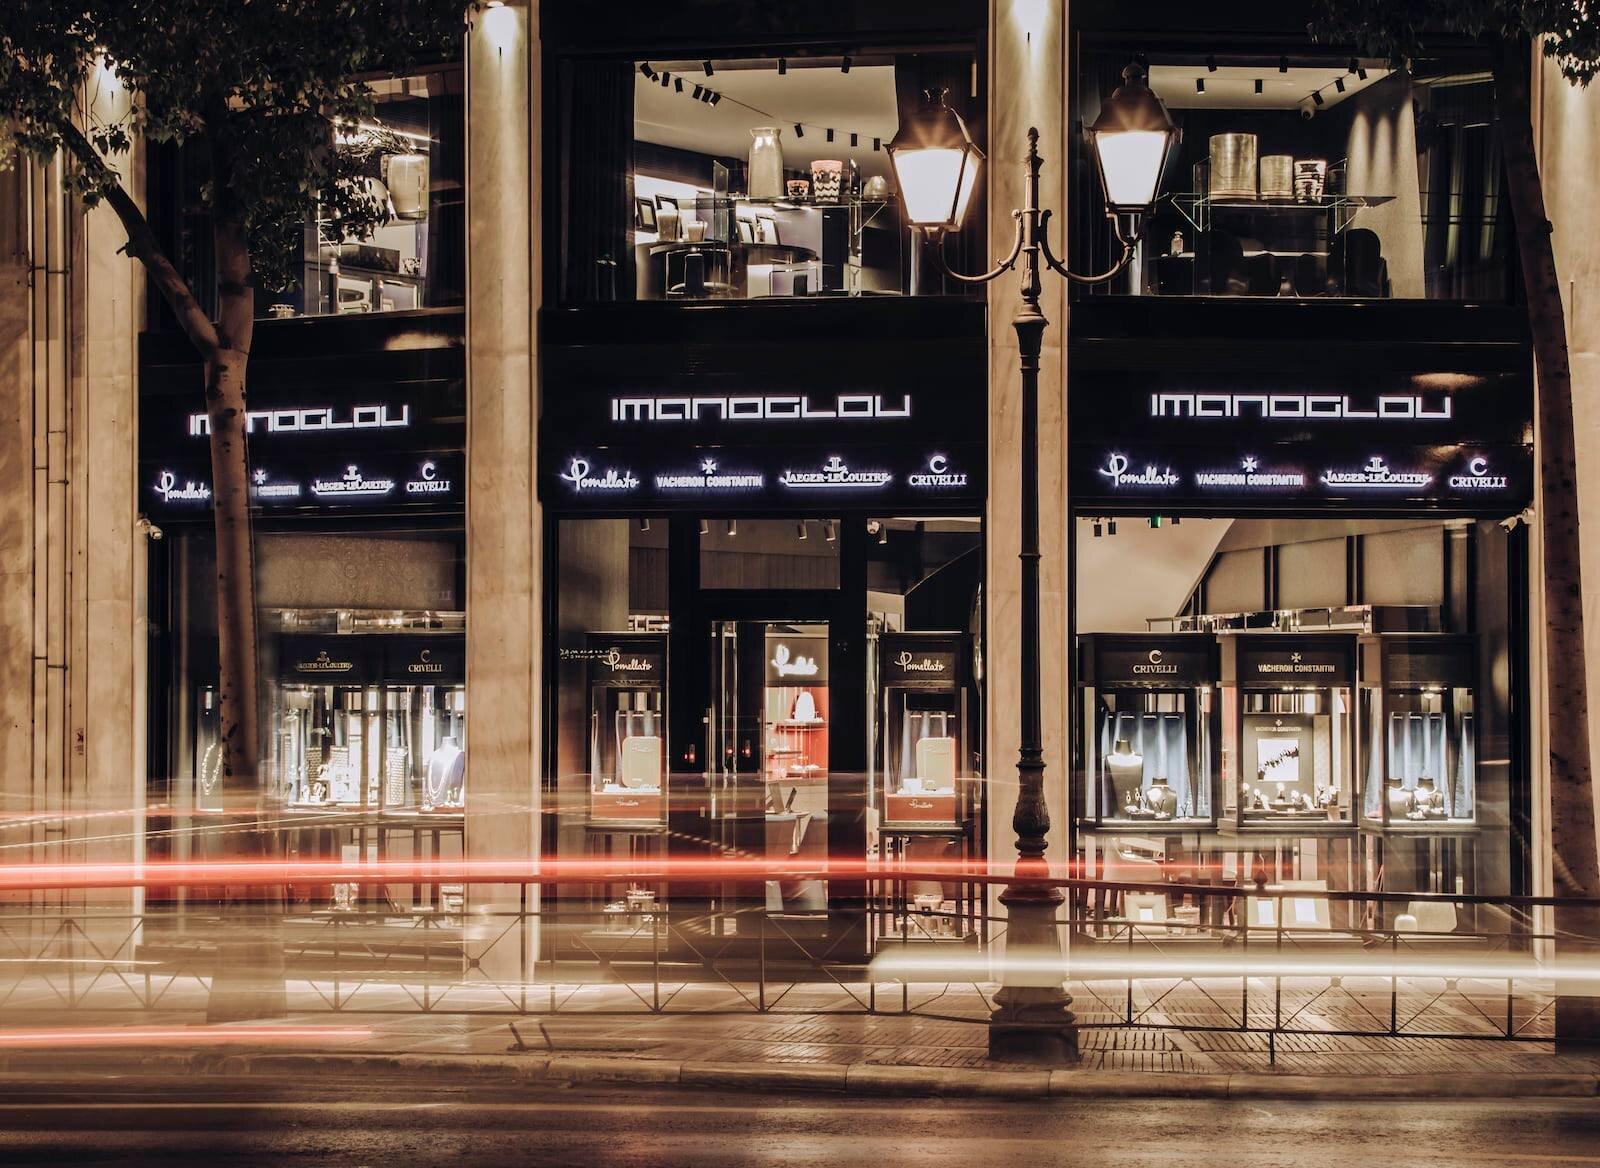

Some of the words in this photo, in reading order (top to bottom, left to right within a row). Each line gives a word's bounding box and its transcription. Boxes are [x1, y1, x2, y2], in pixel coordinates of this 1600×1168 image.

[560, 457, 640, 492] Pomellato
[1099, 453, 1180, 487] Pomellato
[406, 480, 450, 492] CRIVELLI
[656, 476, 705, 488] VACHERON
[706, 475, 763, 487] CONSTANTIN
[908, 474, 967, 487] CRIVELLI
[1196, 474, 1245, 486] VACHERON
[1246, 474, 1304, 486] CONSTANTIN
[1449, 476, 1507, 488] CRIVELLI
[602, 650, 653, 672] Pomellato
[894, 651, 946, 672] Pomellato
[407, 664, 442, 673] CRIVELLI
[1132, 664, 1178, 674] CRIVELLI
[1257, 664, 1294, 673] VACHERON
[1295, 664, 1335, 673] CONSTANTIN
